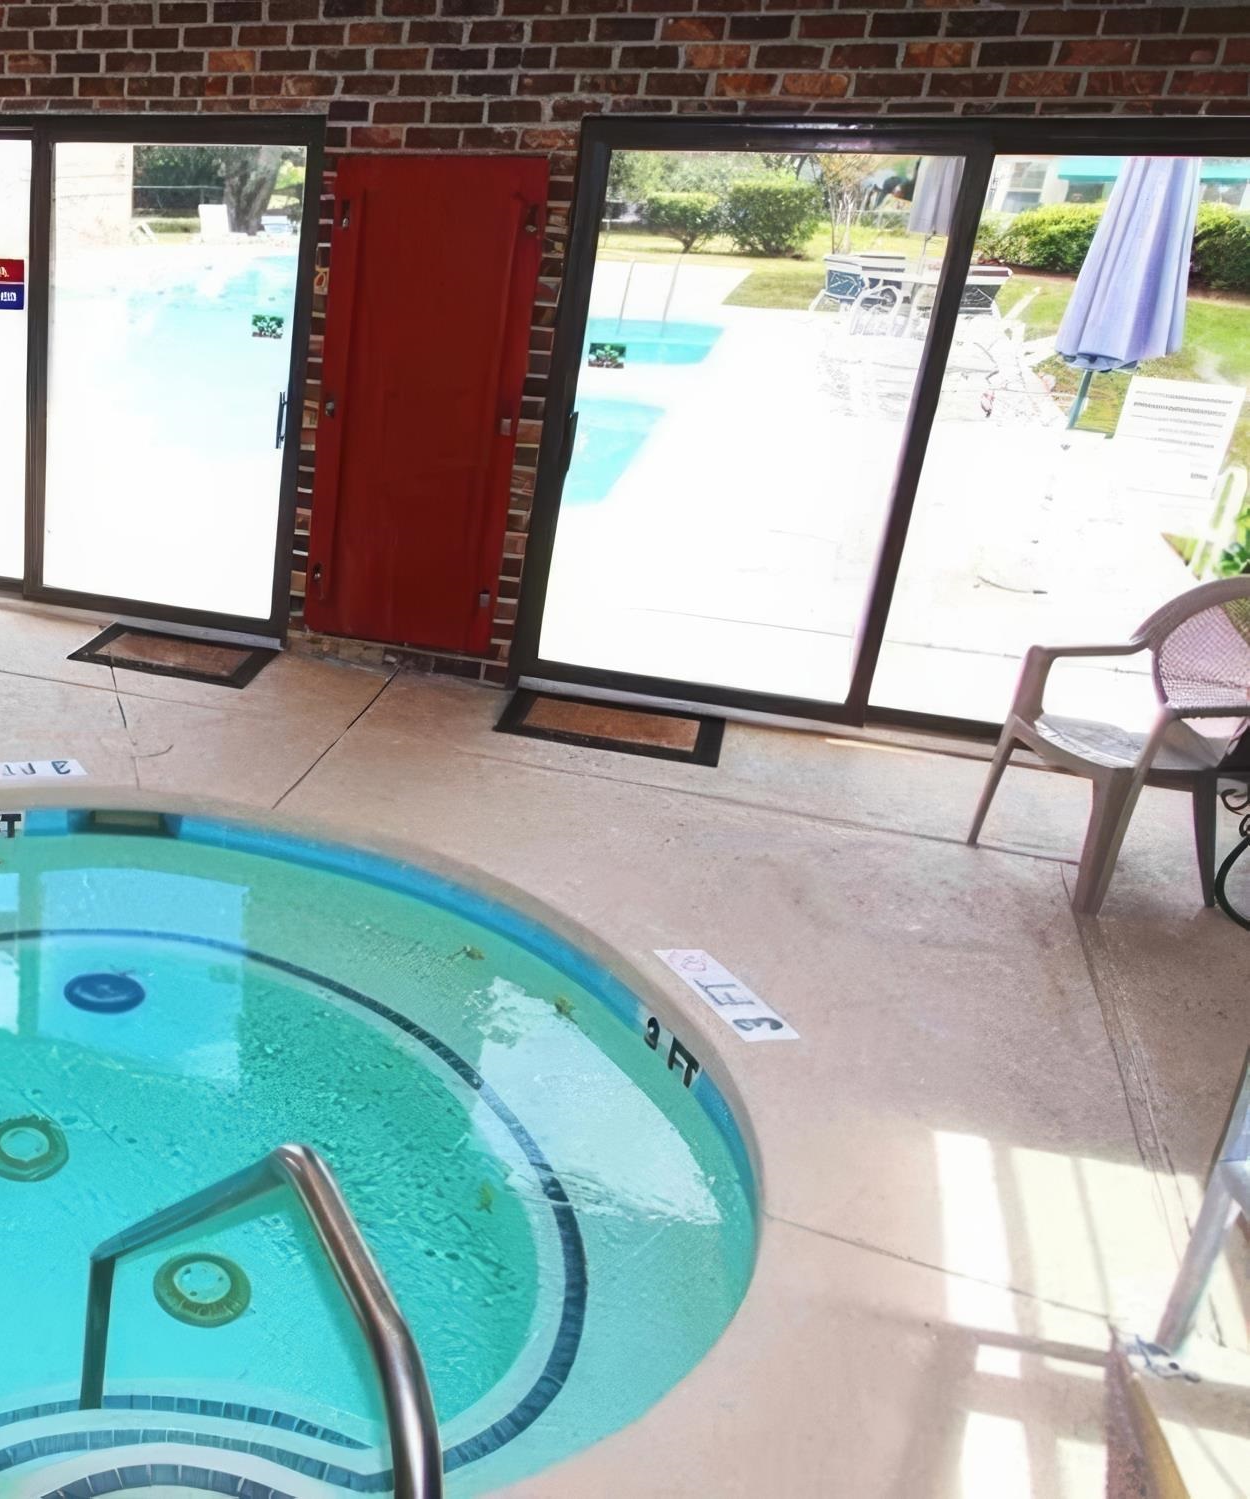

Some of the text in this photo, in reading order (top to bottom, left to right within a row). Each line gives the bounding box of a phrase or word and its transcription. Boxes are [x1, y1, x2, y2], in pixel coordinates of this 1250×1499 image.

[694, 979, 784, 1031] 3 FT
[644, 1016, 700, 1088] 3 FT
